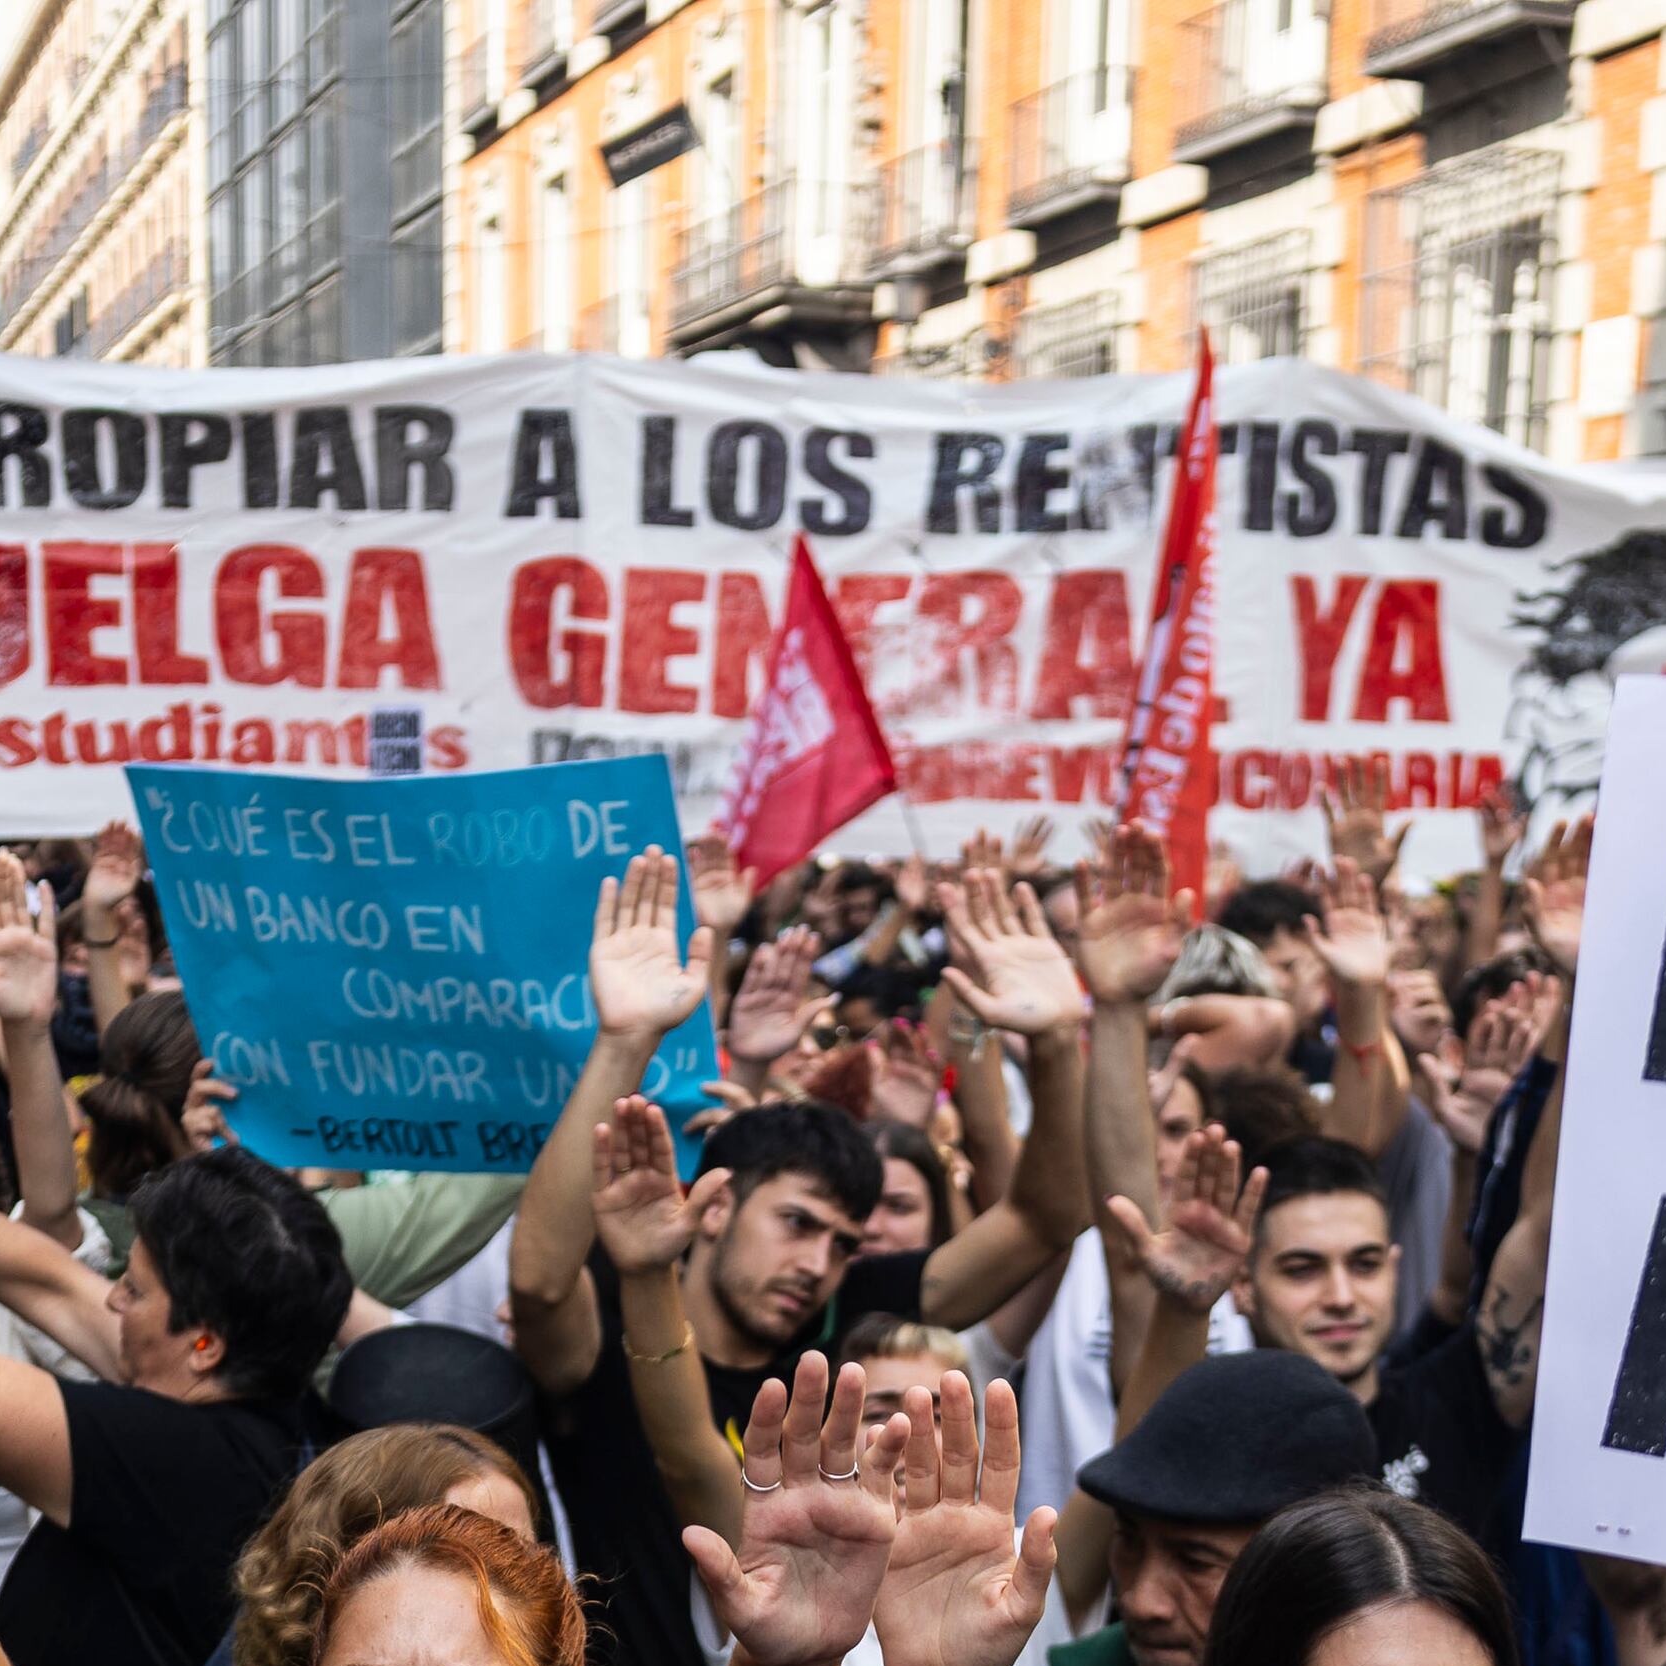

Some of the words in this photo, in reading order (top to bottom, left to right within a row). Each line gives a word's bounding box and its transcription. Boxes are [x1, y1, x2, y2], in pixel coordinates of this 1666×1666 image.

[503, 408, 582, 518] A
[637, 415, 876, 536] LOS
[1290, 575, 1452, 724] YA
[284, 808, 337, 864] ES
[348, 813, 416, 868] EL
[427, 804, 554, 869] ROBO
[568, 799, 632, 859] DE
[176, 879, 238, 933] UN
[244, 885, 391, 951] BANCO
[406, 902, 487, 955] EN
[309, 1040, 495, 1102] FUNDAR
[477, 1120, 552, 1163] BRE
